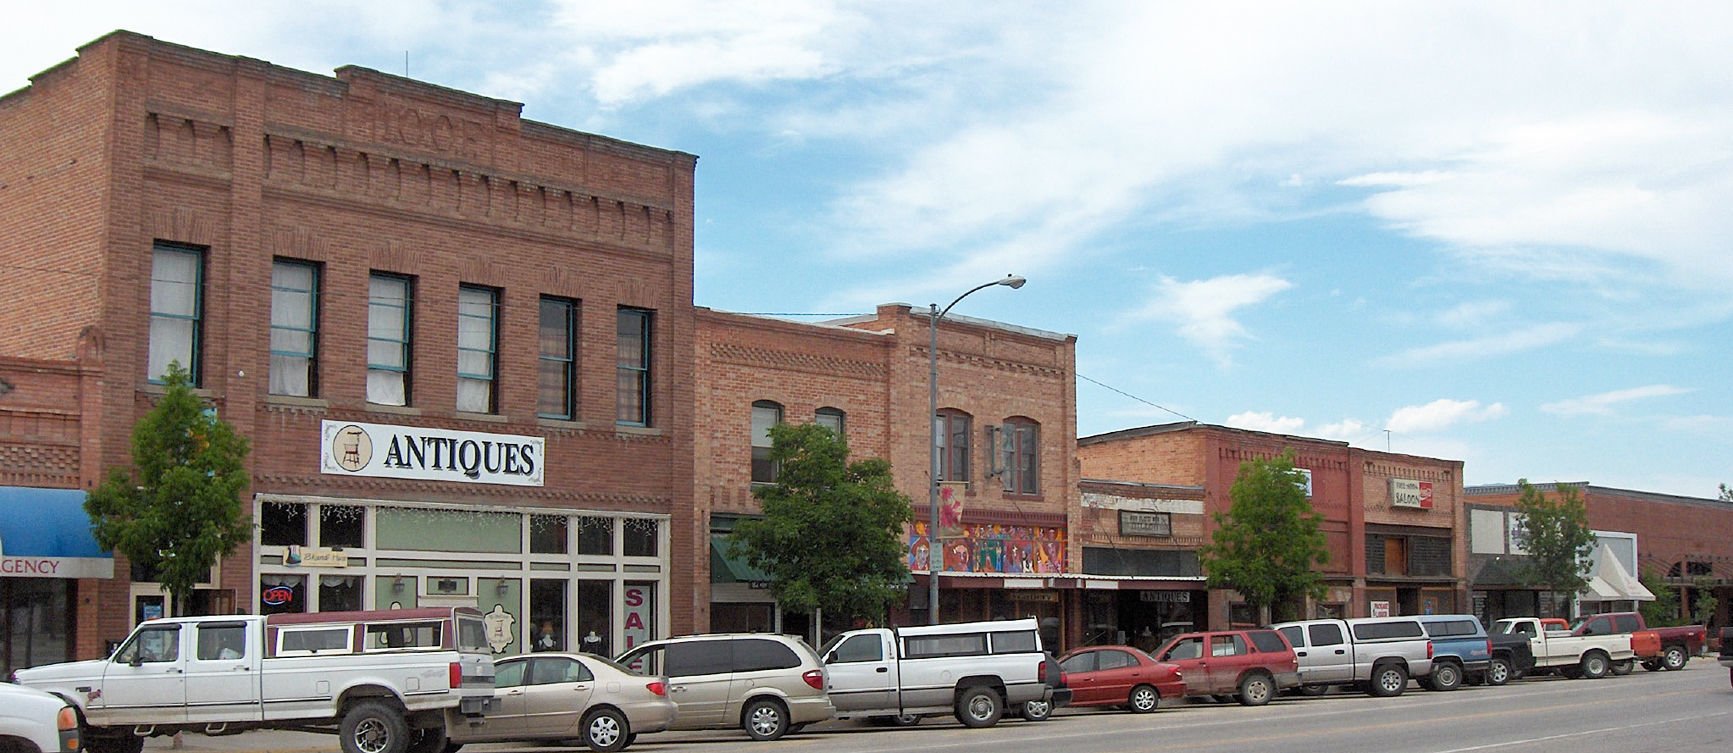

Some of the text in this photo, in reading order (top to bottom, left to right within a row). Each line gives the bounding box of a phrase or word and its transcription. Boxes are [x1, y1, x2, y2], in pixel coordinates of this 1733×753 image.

[384, 434, 535, 479] ANTIQUES
[0, 559, 60, 573] GENCY
[263, 590, 292, 602] OPEN
